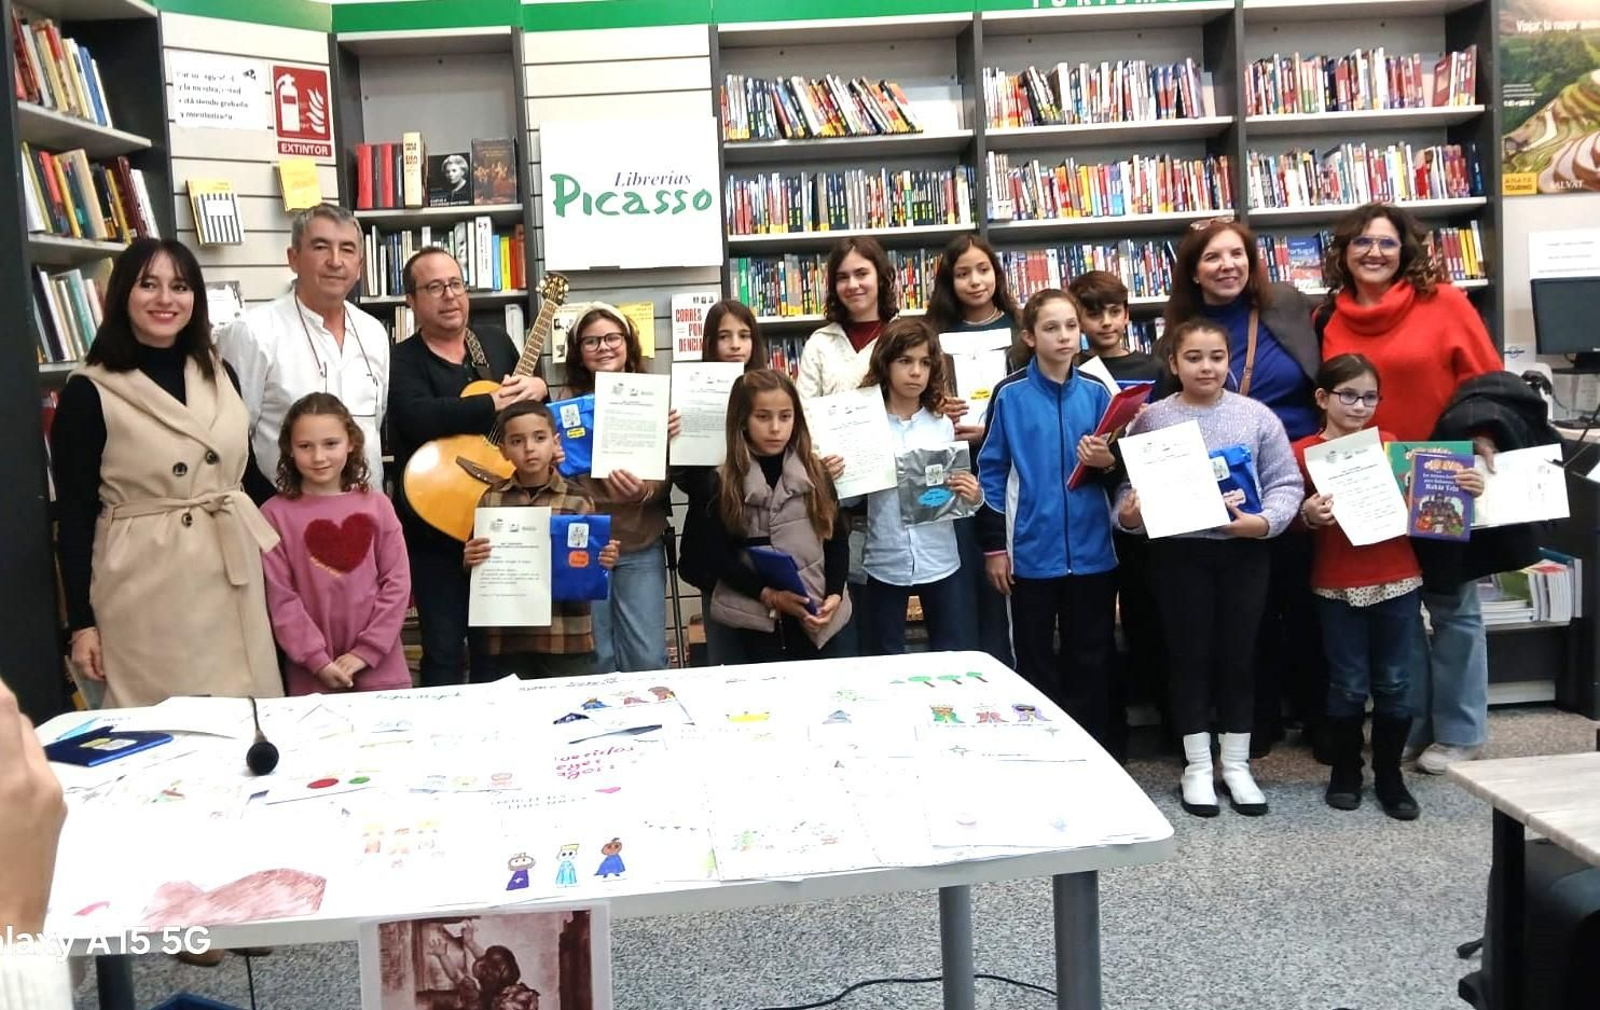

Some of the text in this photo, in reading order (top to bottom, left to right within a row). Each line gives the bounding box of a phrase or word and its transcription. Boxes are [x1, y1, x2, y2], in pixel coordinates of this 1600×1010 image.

[280, 142, 329, 156] EXTINTOR
[614, 169, 692, 187] Librerías
[549, 173, 713, 218] Picasso
[675, 308, 702, 323] CORRES
[688, 323, 703, 337] PON
